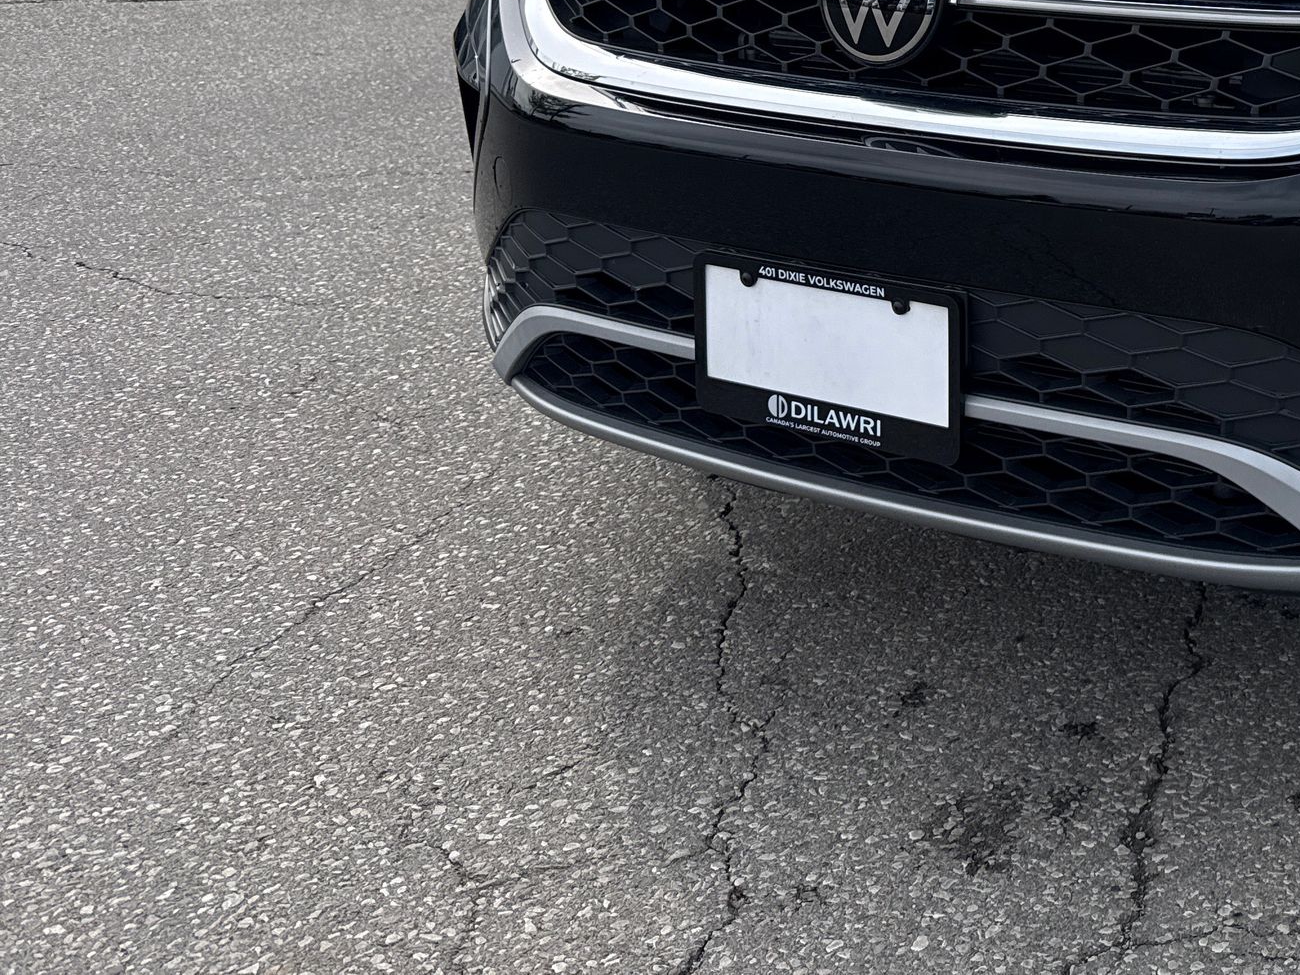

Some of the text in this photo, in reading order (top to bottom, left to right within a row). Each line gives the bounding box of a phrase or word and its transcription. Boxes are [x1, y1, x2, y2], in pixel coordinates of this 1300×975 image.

[758, 266, 885, 297] 401 DIXIE VOLKSWAGEN
[765, 416, 881, 447] CANADA'S LARGEST AUTOMOTIVE GROUP
[790, 400, 881, 437] DILAWRI
